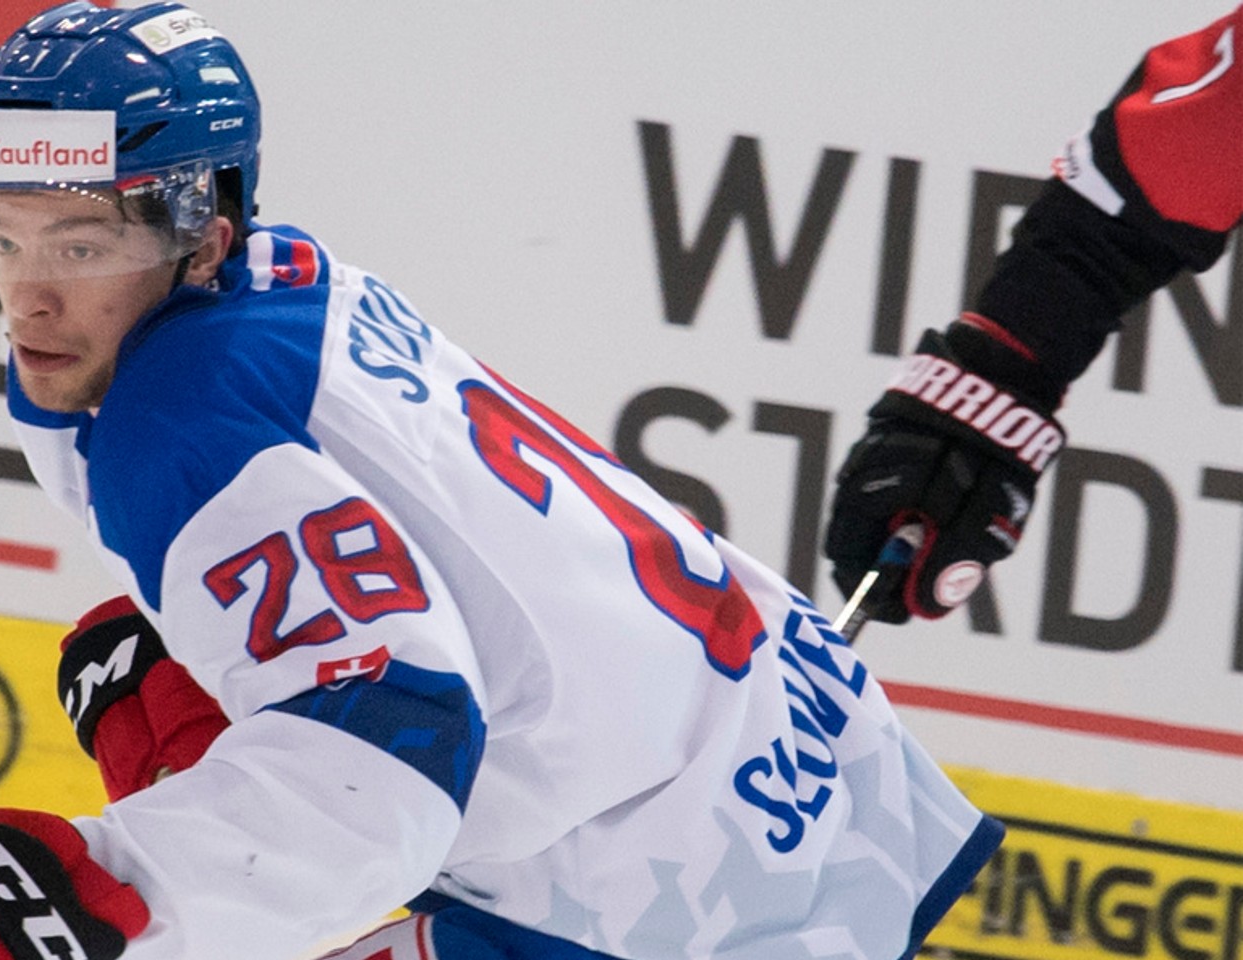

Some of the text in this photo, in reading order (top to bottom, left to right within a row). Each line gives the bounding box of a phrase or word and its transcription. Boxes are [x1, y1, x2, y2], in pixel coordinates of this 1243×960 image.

[209, 117, 245, 132] CCM
[886, 353, 1065, 473] ARRIOR
[202, 496, 430, 664] 28
[613, 386, 1243, 677] STD
